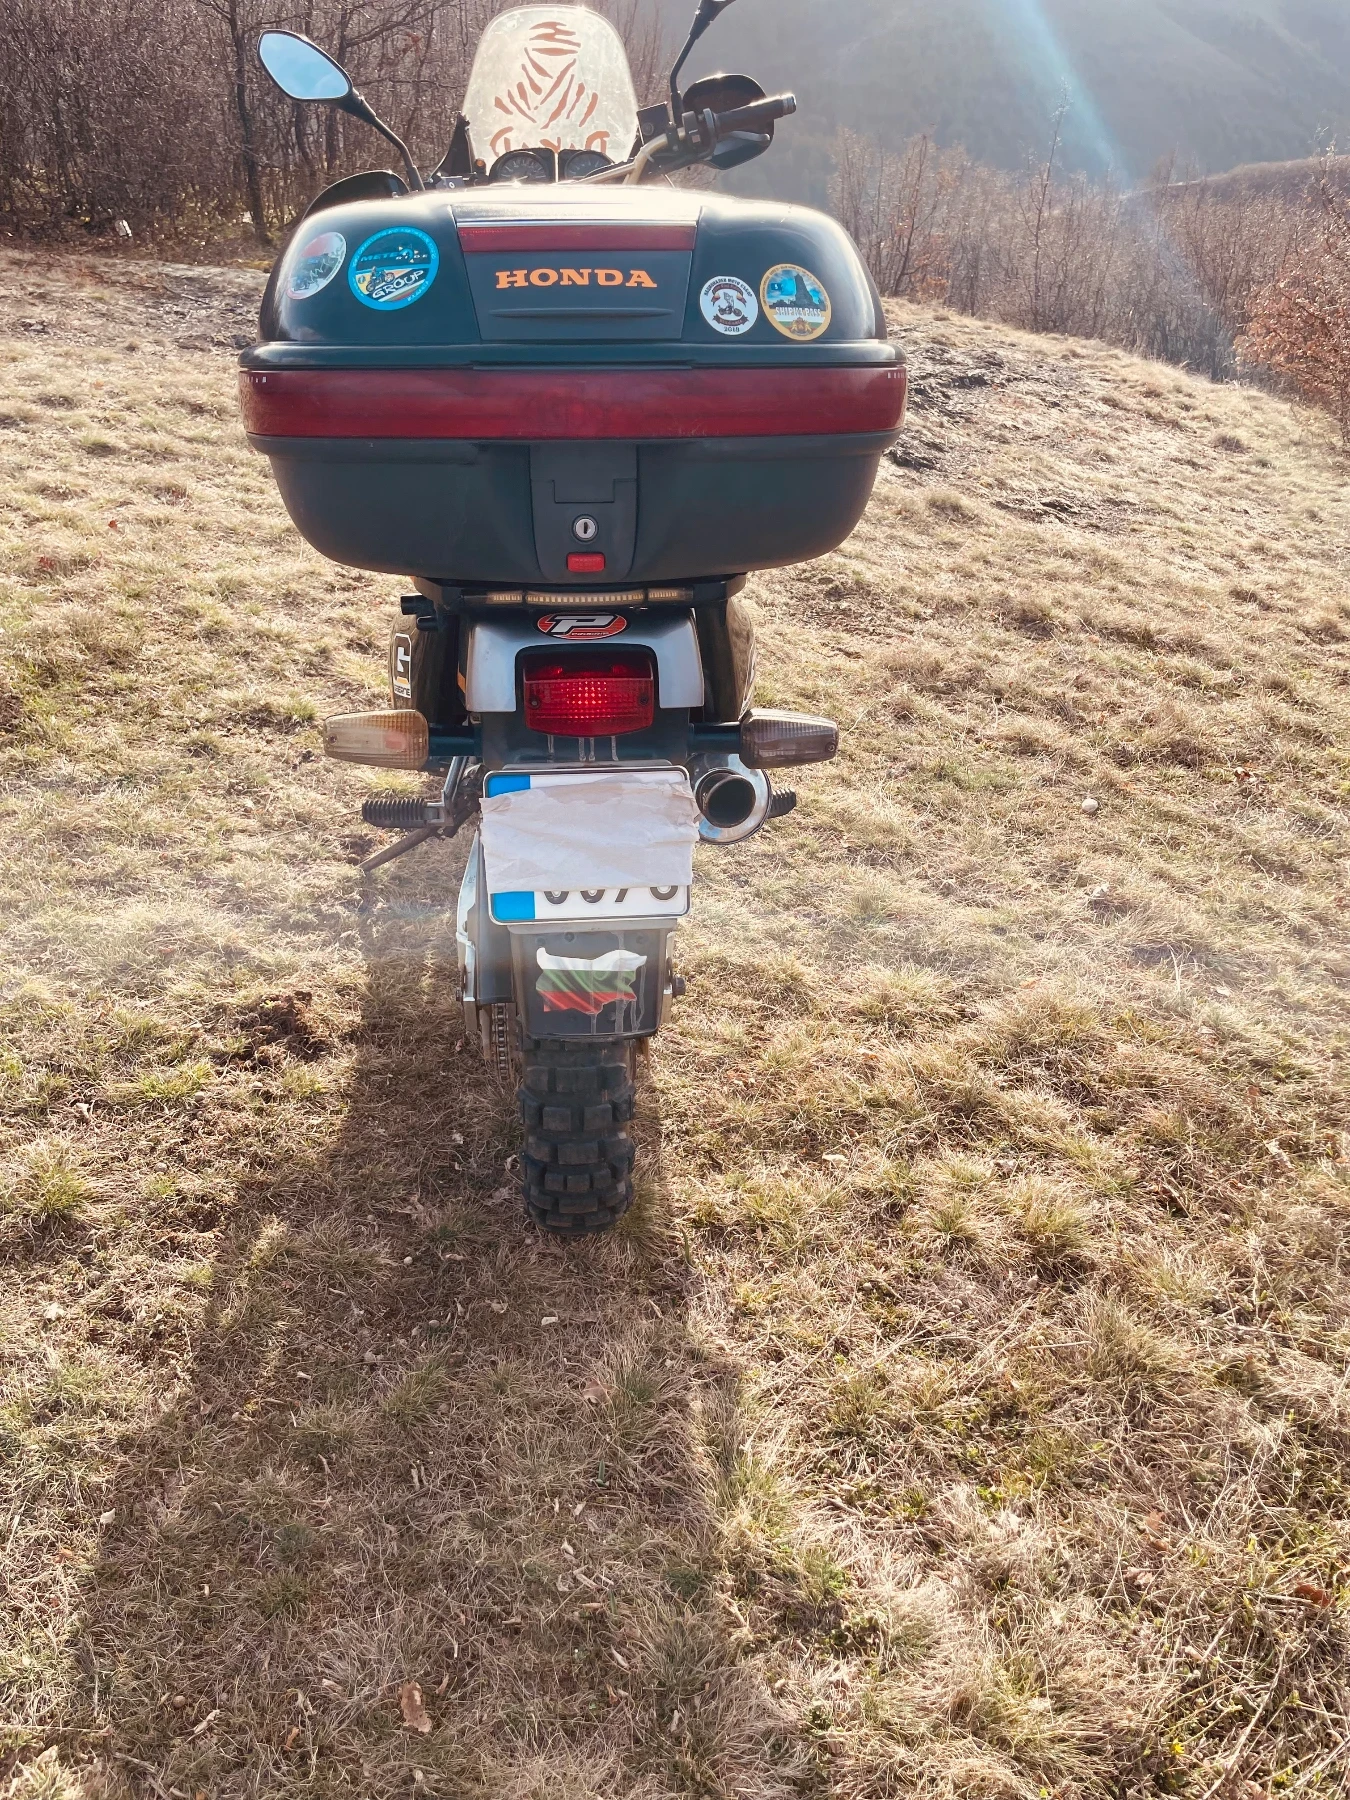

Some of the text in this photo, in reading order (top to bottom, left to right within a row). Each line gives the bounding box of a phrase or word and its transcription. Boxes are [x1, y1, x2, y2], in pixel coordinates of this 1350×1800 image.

[372, 269, 424, 299] GROUP
[496, 268, 658, 289] HONDA
[775, 307, 822, 317] SHIPKA PASS
